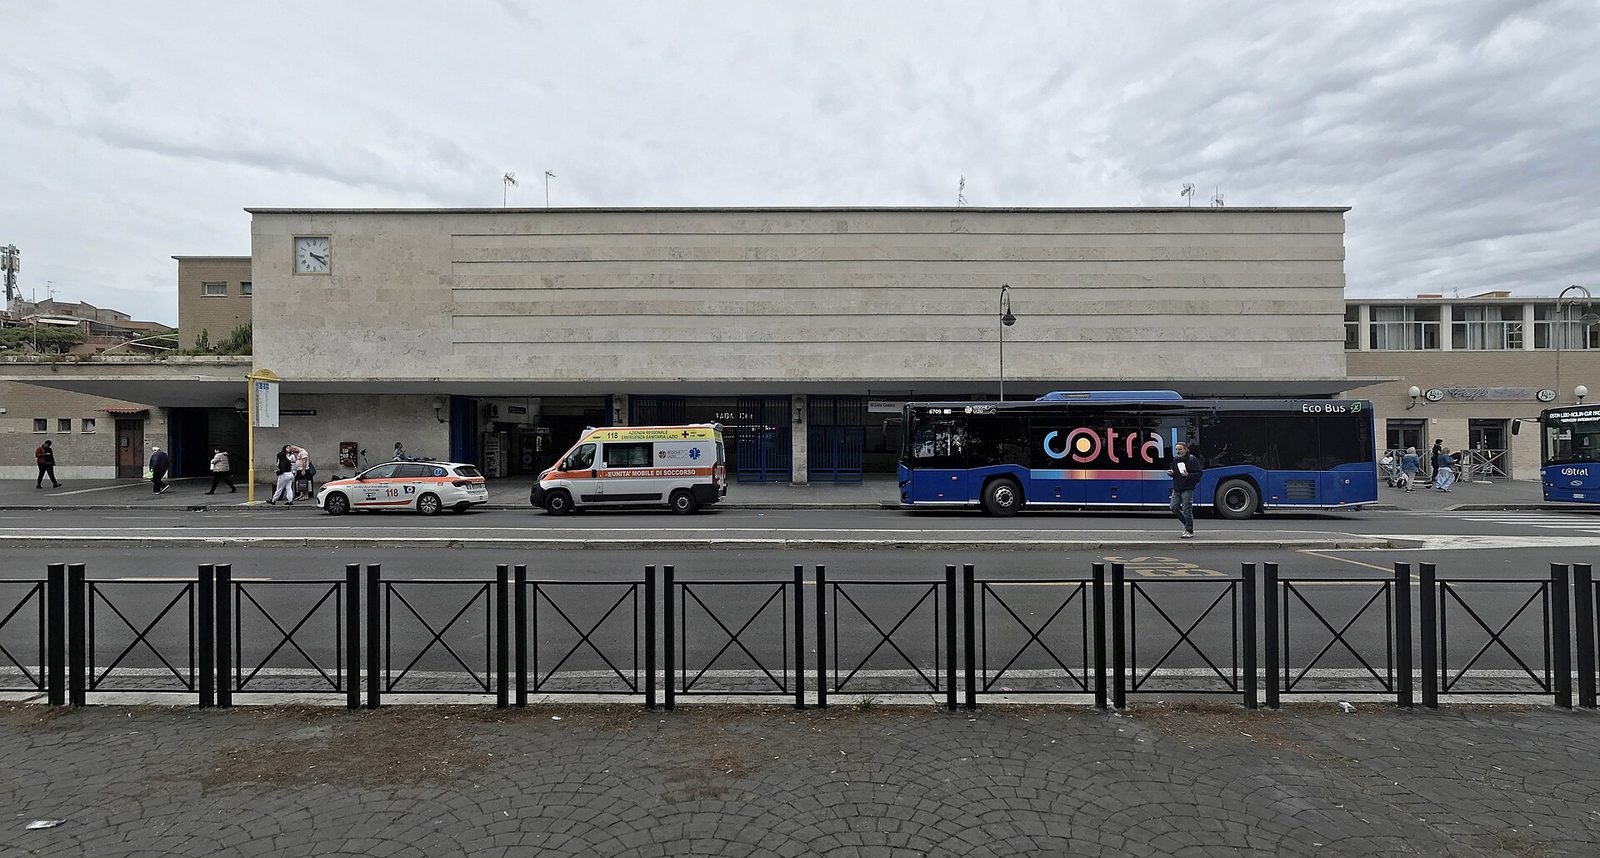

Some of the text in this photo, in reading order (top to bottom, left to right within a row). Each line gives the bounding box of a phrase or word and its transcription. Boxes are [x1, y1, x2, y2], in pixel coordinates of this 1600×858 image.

[1302, 403, 1346, 413] Eco Bus
[1044, 427, 1178, 463] cotral
[1561, 468, 1589, 476] cotral
[386, 488, 399, 497] 118
